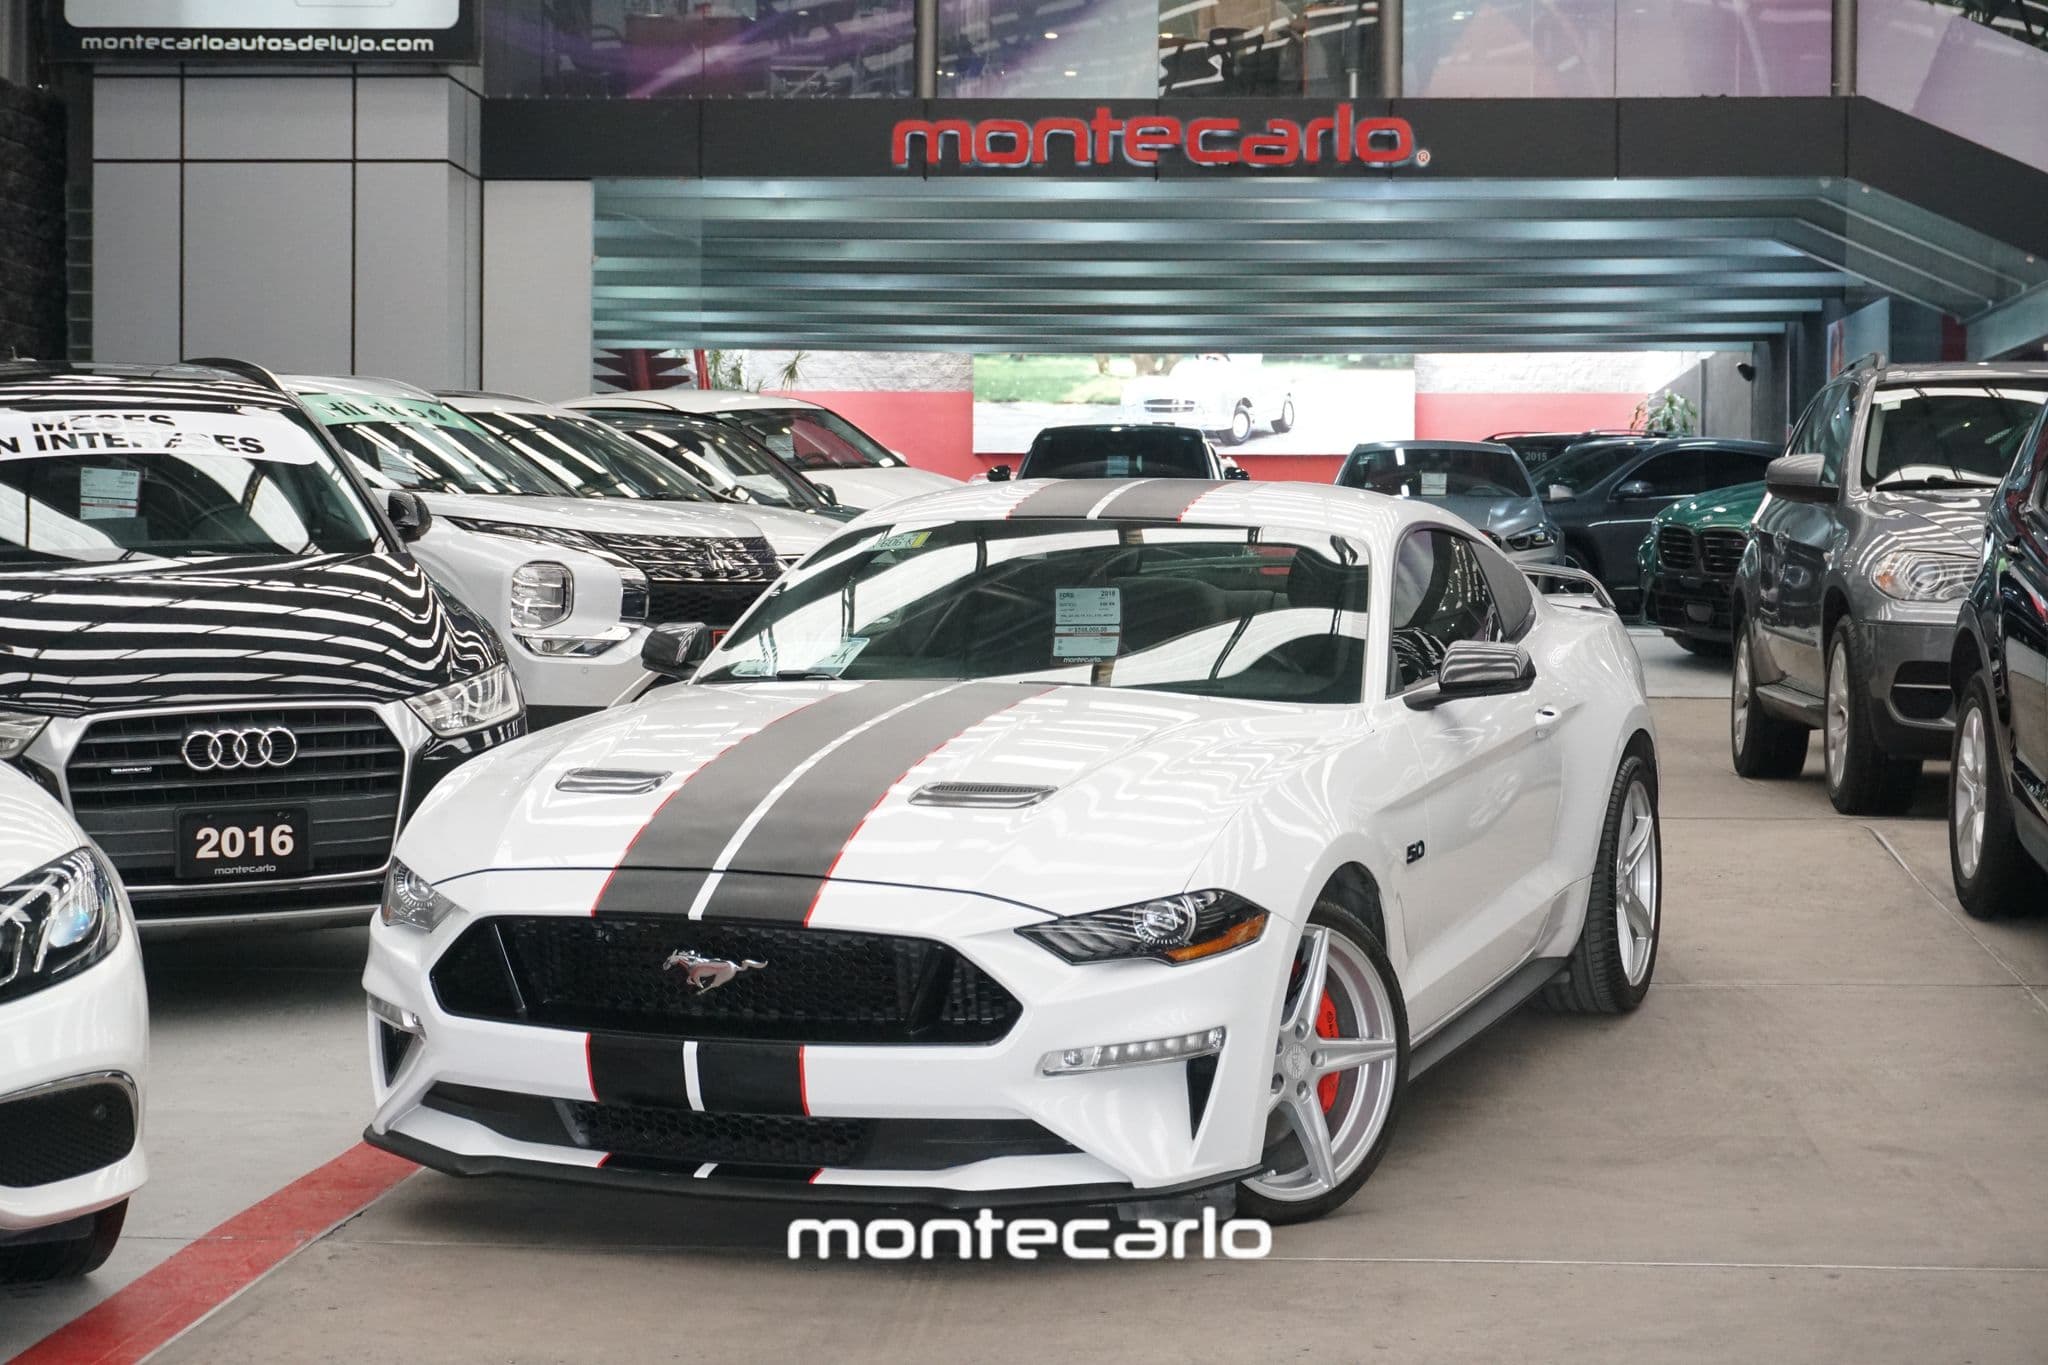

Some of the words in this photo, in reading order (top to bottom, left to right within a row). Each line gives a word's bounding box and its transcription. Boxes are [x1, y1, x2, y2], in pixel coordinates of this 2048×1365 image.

[81, 34, 435, 54] montecarloautosdelujo.com
[1525, 452, 1548, 462] 2015
[195, 824, 295, 859] 2016
[214, 864, 277, 875] montecarlo
